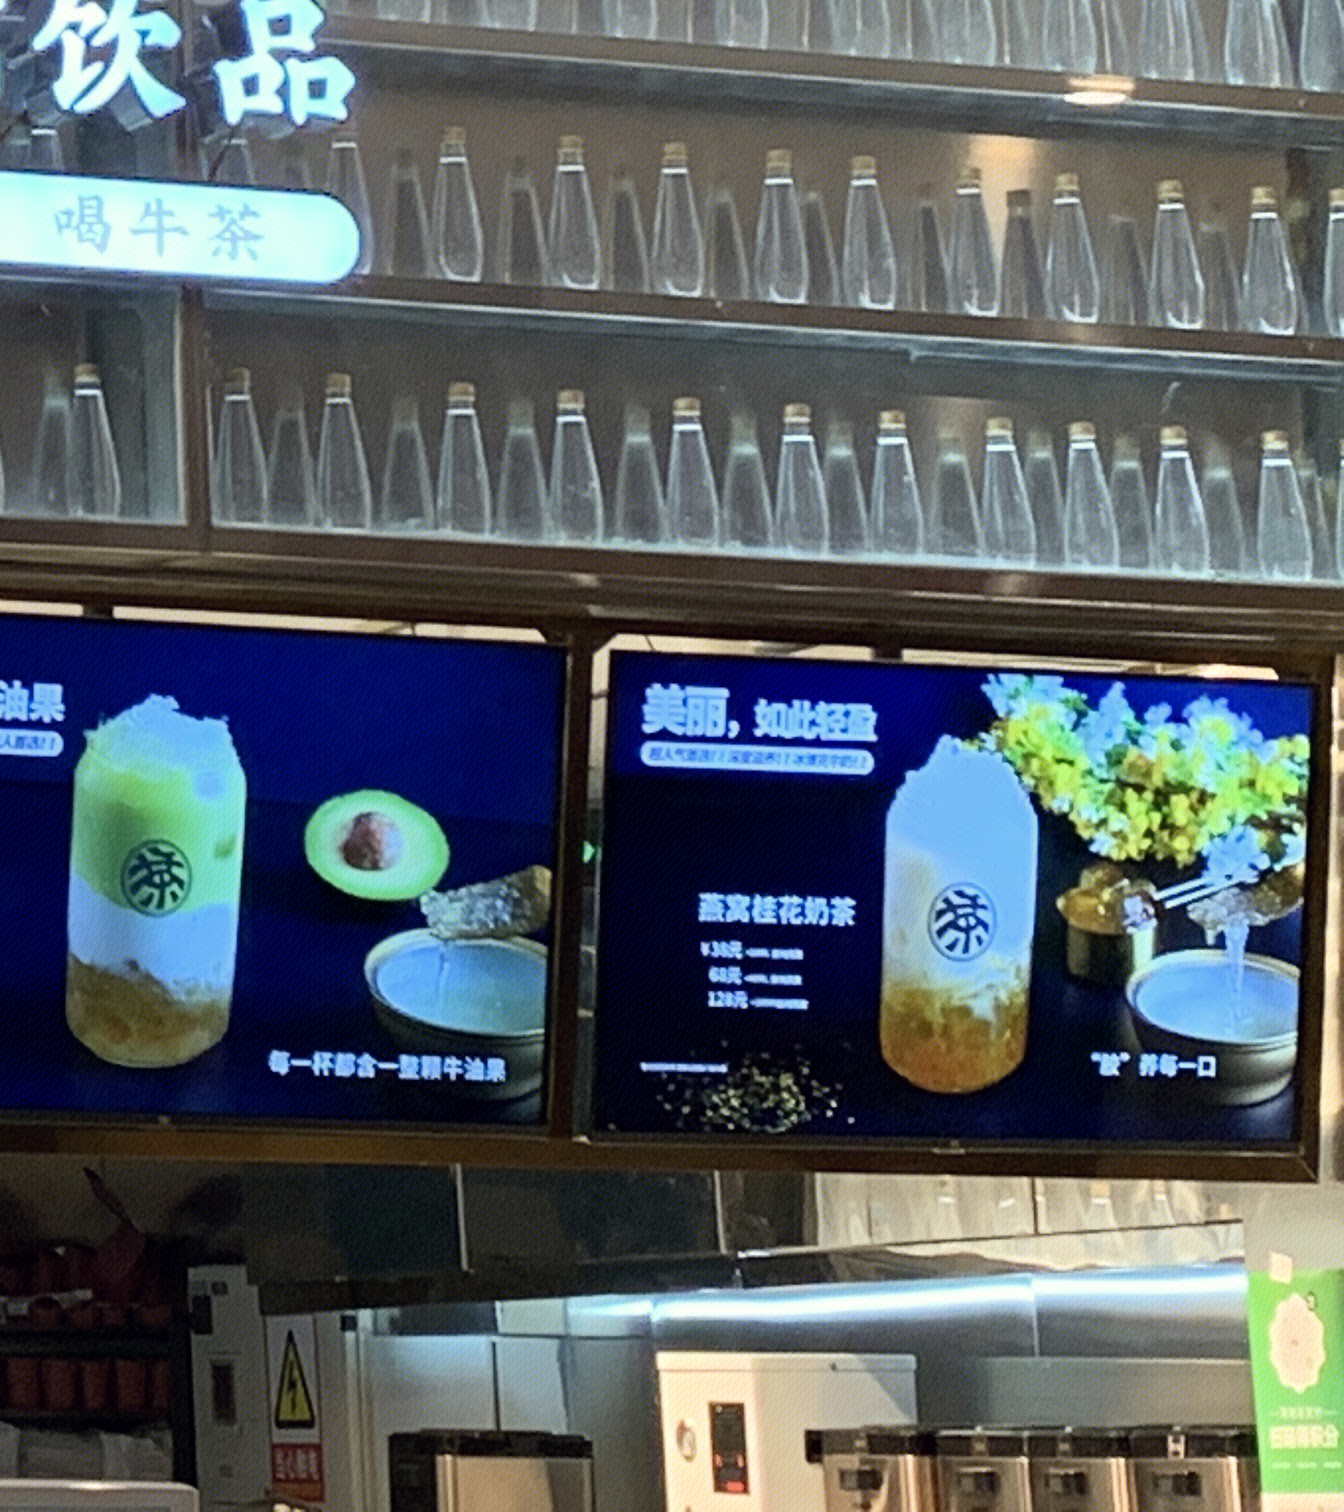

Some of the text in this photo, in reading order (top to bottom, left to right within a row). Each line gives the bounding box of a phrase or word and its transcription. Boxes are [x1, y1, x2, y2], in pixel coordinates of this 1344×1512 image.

[54, 197, 265, 261] 喝牛茶
[698, 893, 856, 926] 燕窝桂花奶茶
